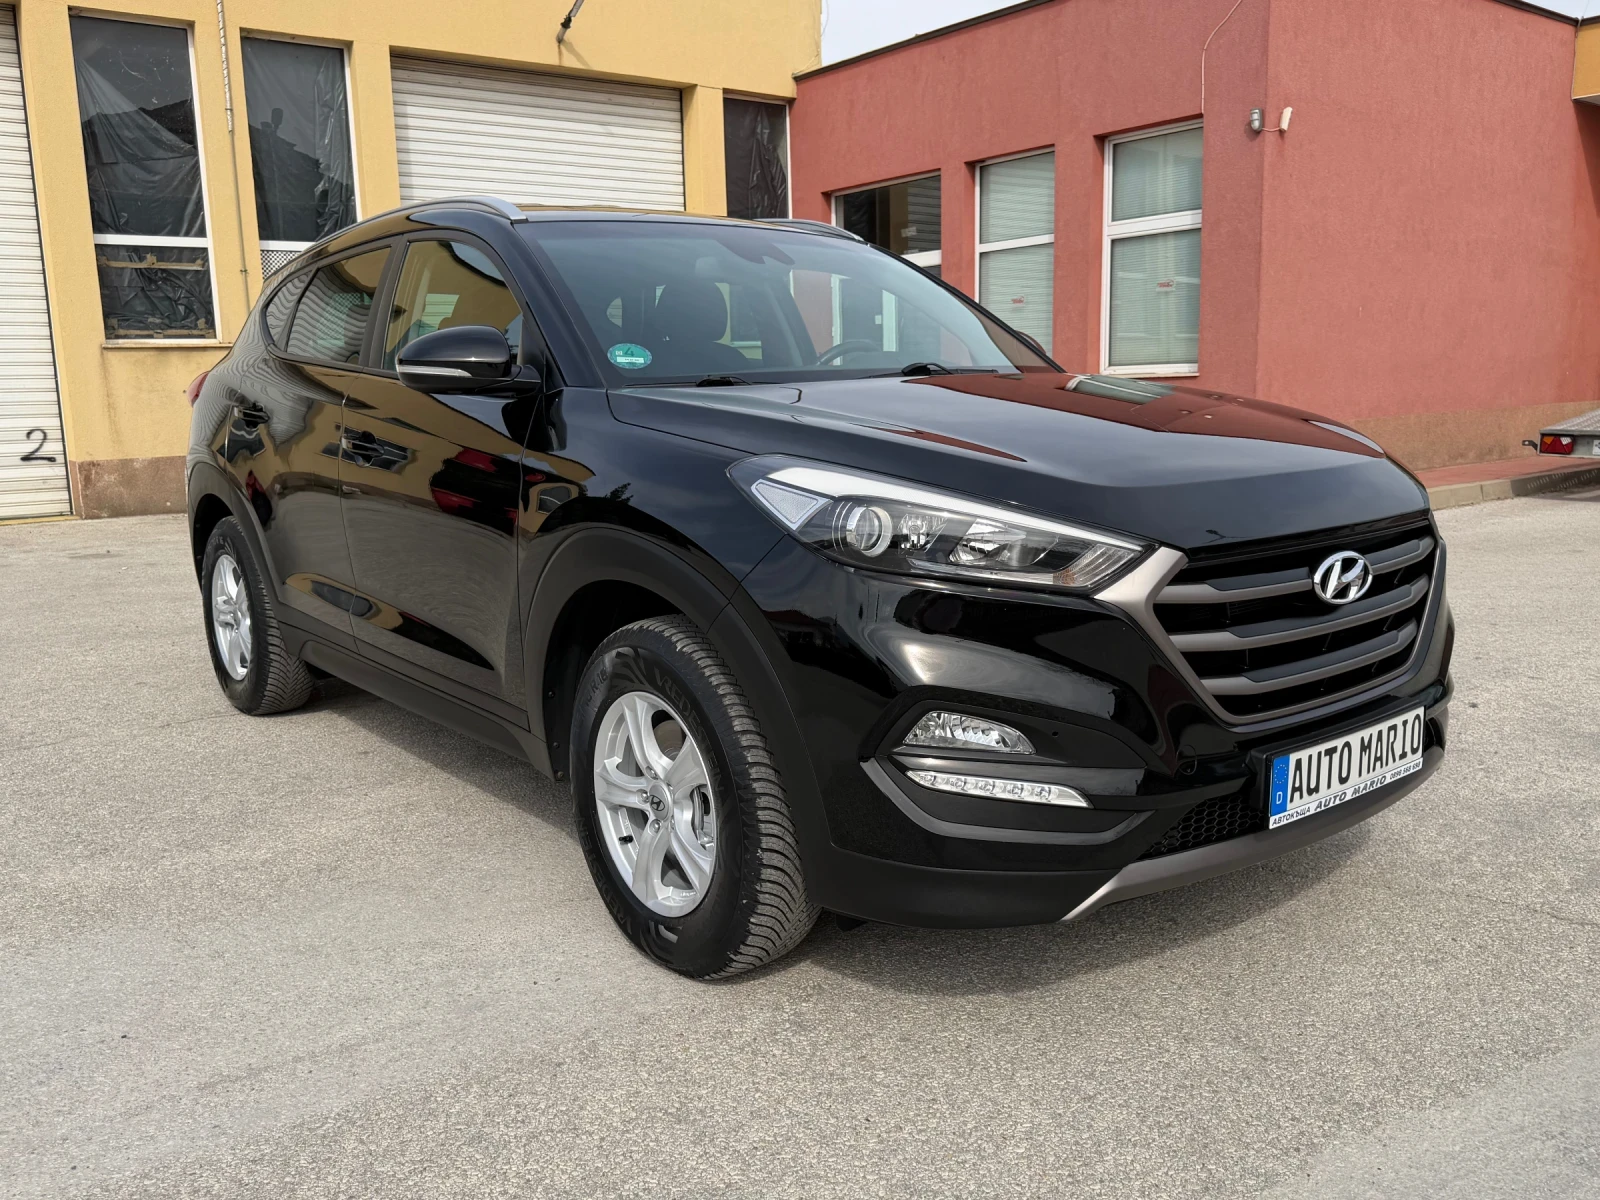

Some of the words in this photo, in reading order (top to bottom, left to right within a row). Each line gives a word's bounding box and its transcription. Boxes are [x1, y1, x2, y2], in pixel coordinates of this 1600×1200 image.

[624, 347, 635, 357] 4
[20, 428, 57, 463] 2
[1289, 740, 1353, 804] AUTO
[1358, 713, 1422, 778] MARIO
[1271, 806, 1311, 827] АВТОКЪЩА
[1314, 791, 1347, 812] AUTO
[1351, 775, 1387, 797] MARIO
[1276, 791, 1283, 805] D
